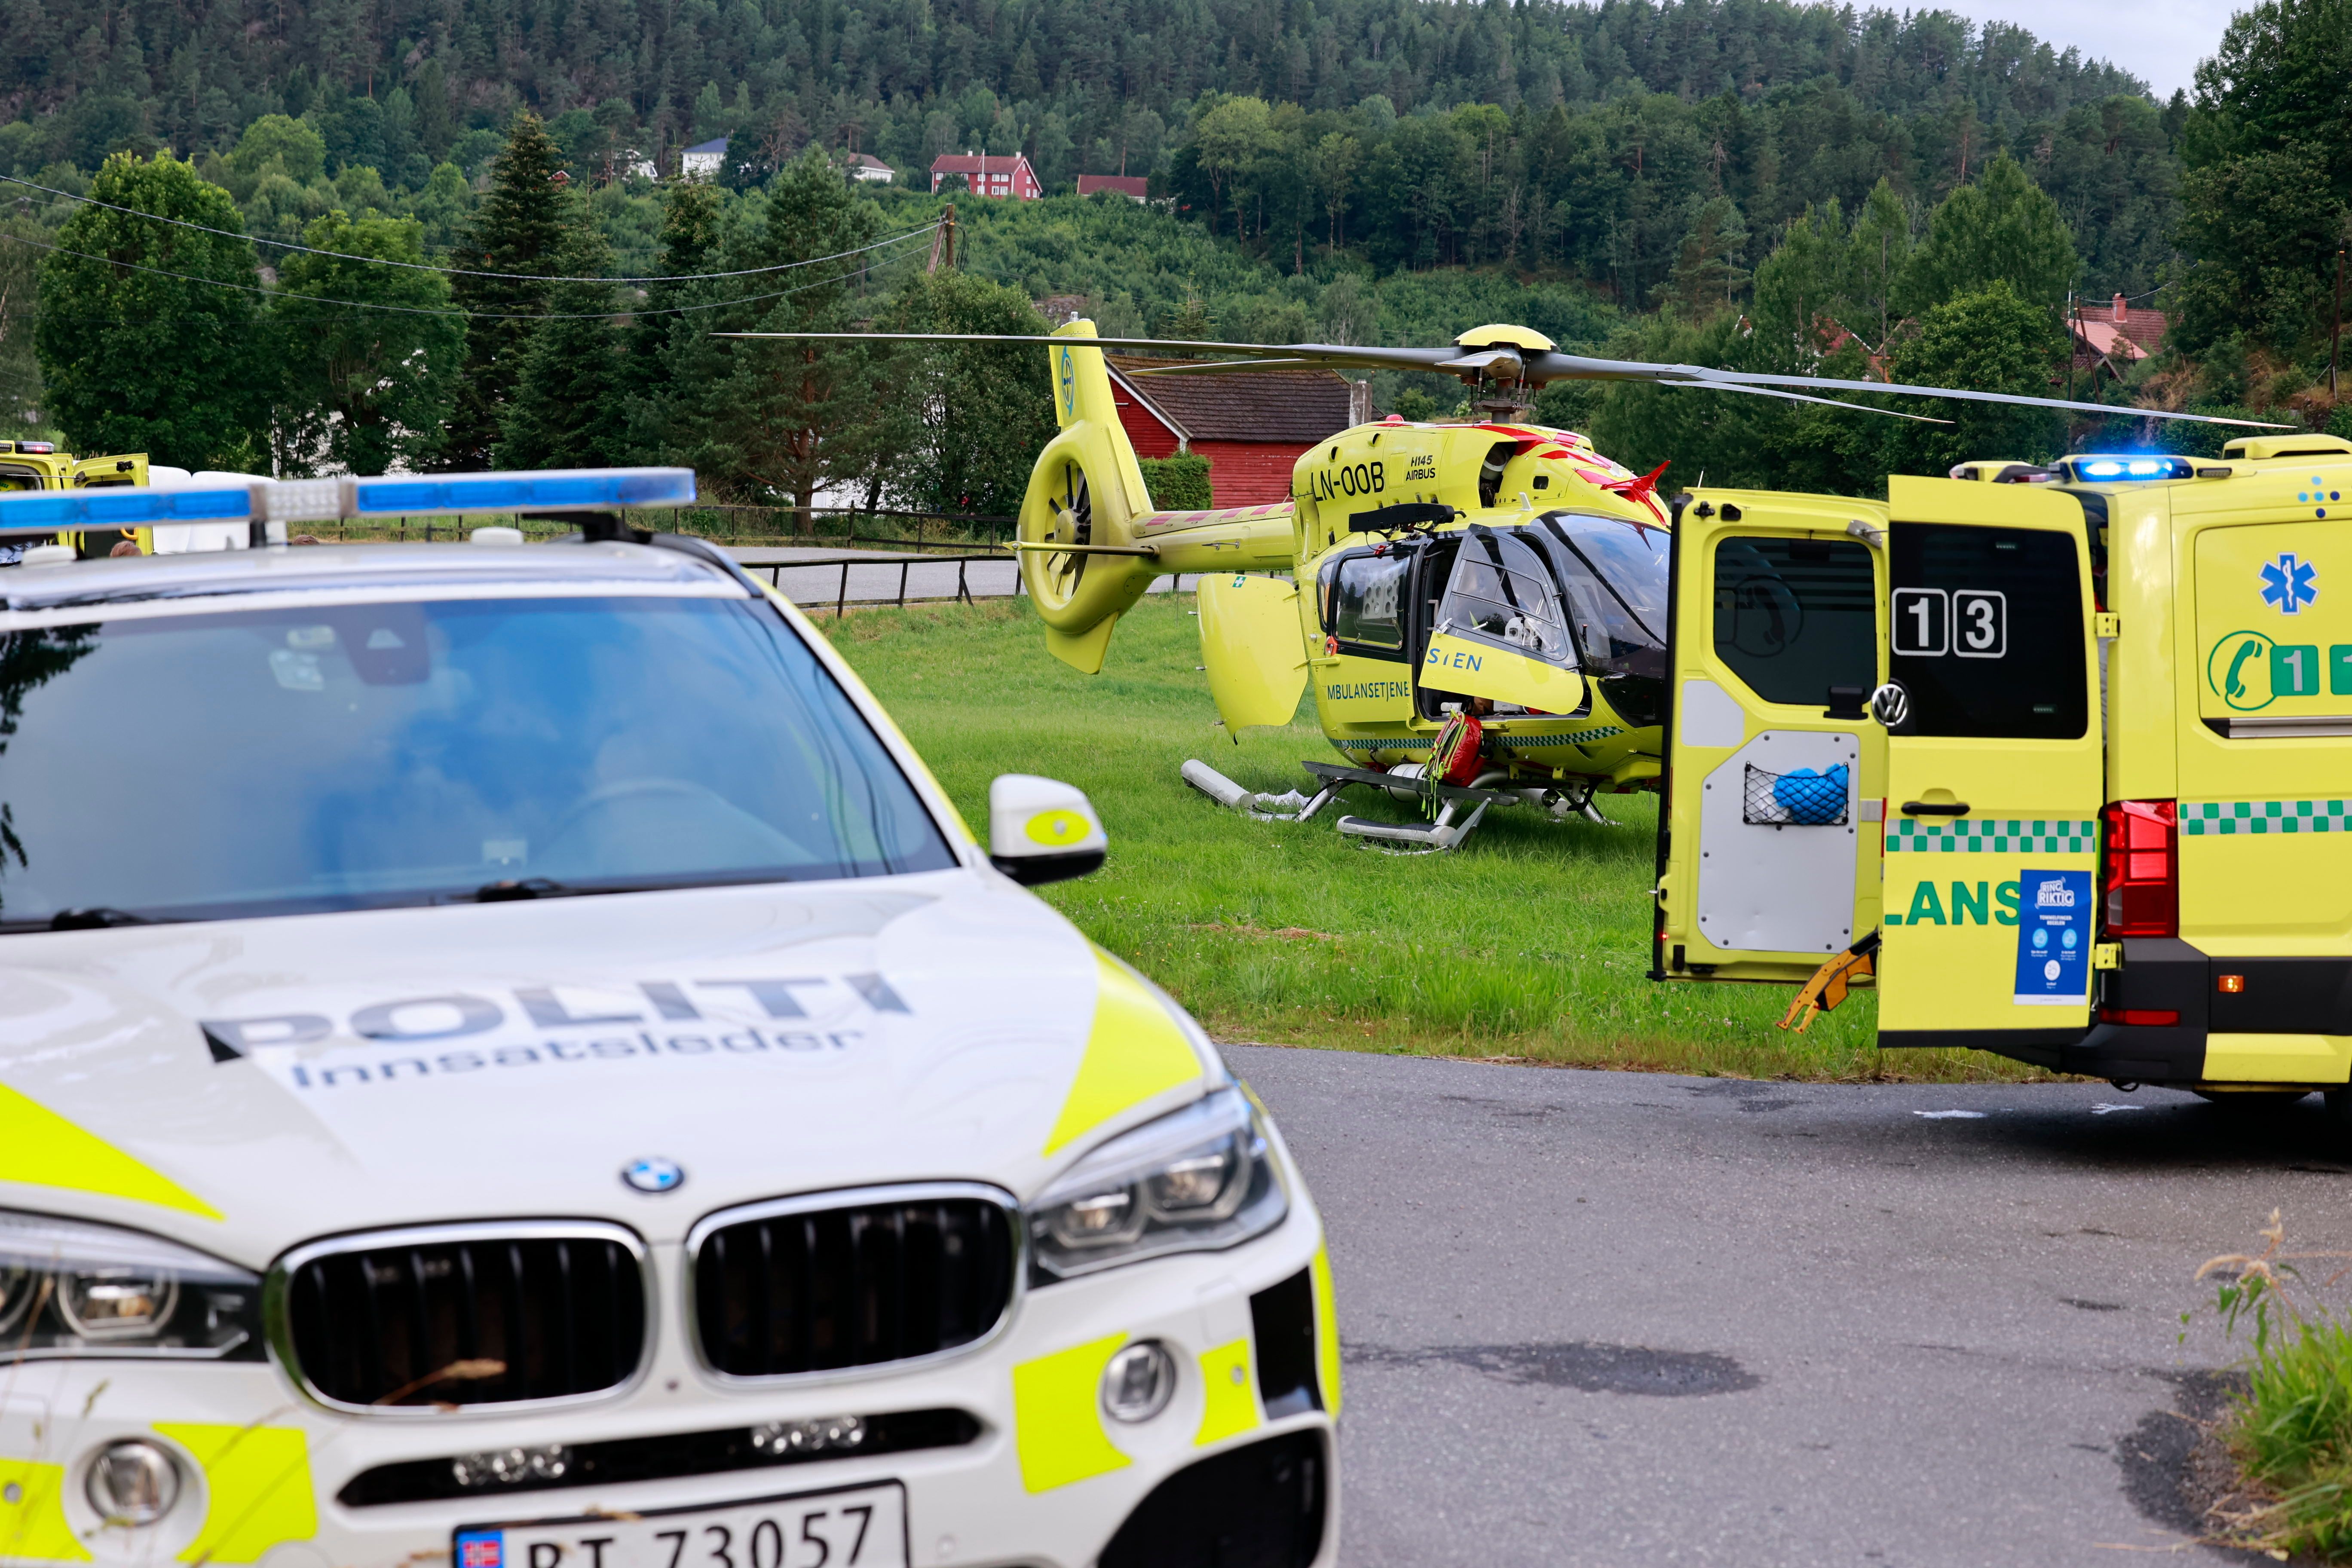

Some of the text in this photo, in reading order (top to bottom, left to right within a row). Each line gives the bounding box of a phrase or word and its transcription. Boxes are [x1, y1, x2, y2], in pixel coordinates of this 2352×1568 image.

[1411, 455, 1433, 467] H145
[1406, 468, 1436, 481] AIRBUS
[2043, 883, 2061, 892] RING
[2040, 892, 2073, 904] RIKTIG
[198, 970, 914, 1064] POLITI
[655, 1505, 873, 1568] 73057
